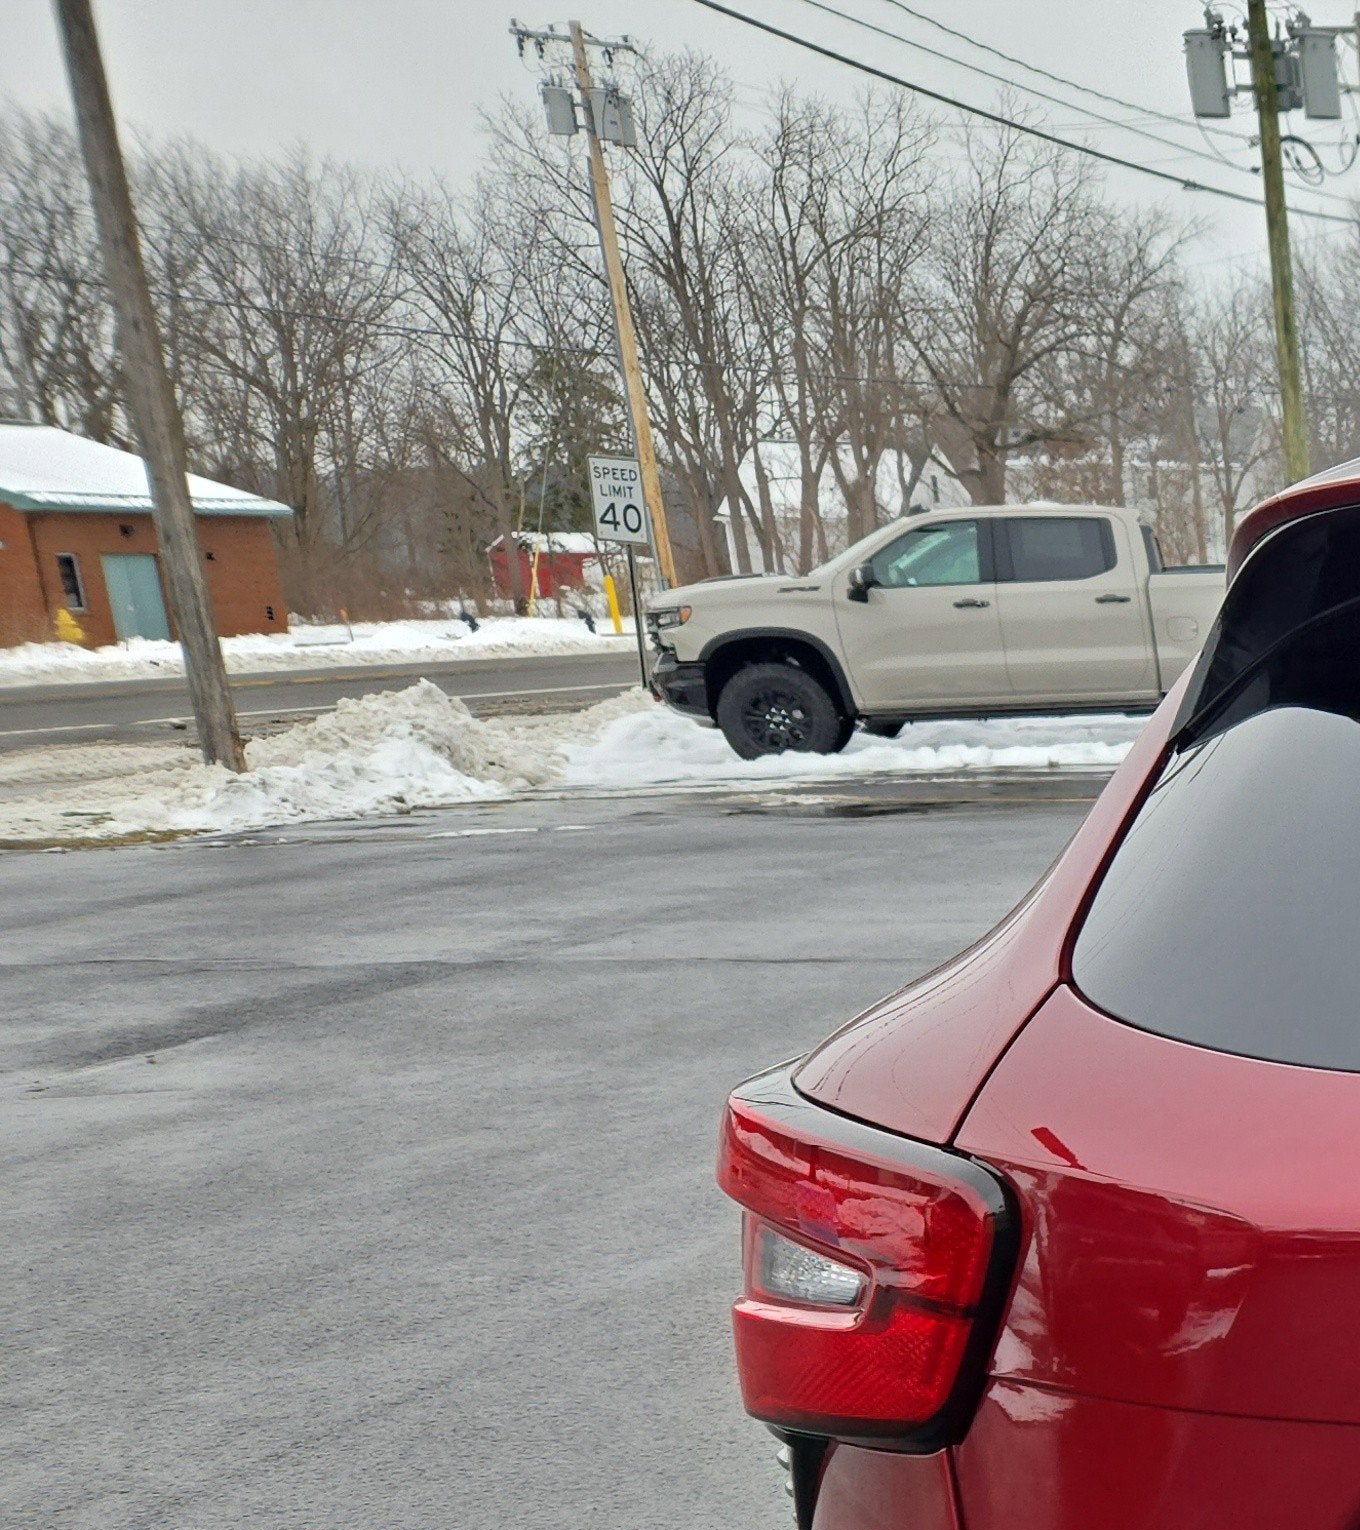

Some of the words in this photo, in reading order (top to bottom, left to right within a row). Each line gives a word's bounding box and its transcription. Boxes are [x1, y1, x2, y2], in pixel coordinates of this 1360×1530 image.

[593, 465, 637, 482] SPEED
[600, 484, 633, 499] LIMIT
[599, 502, 642, 534] 40
